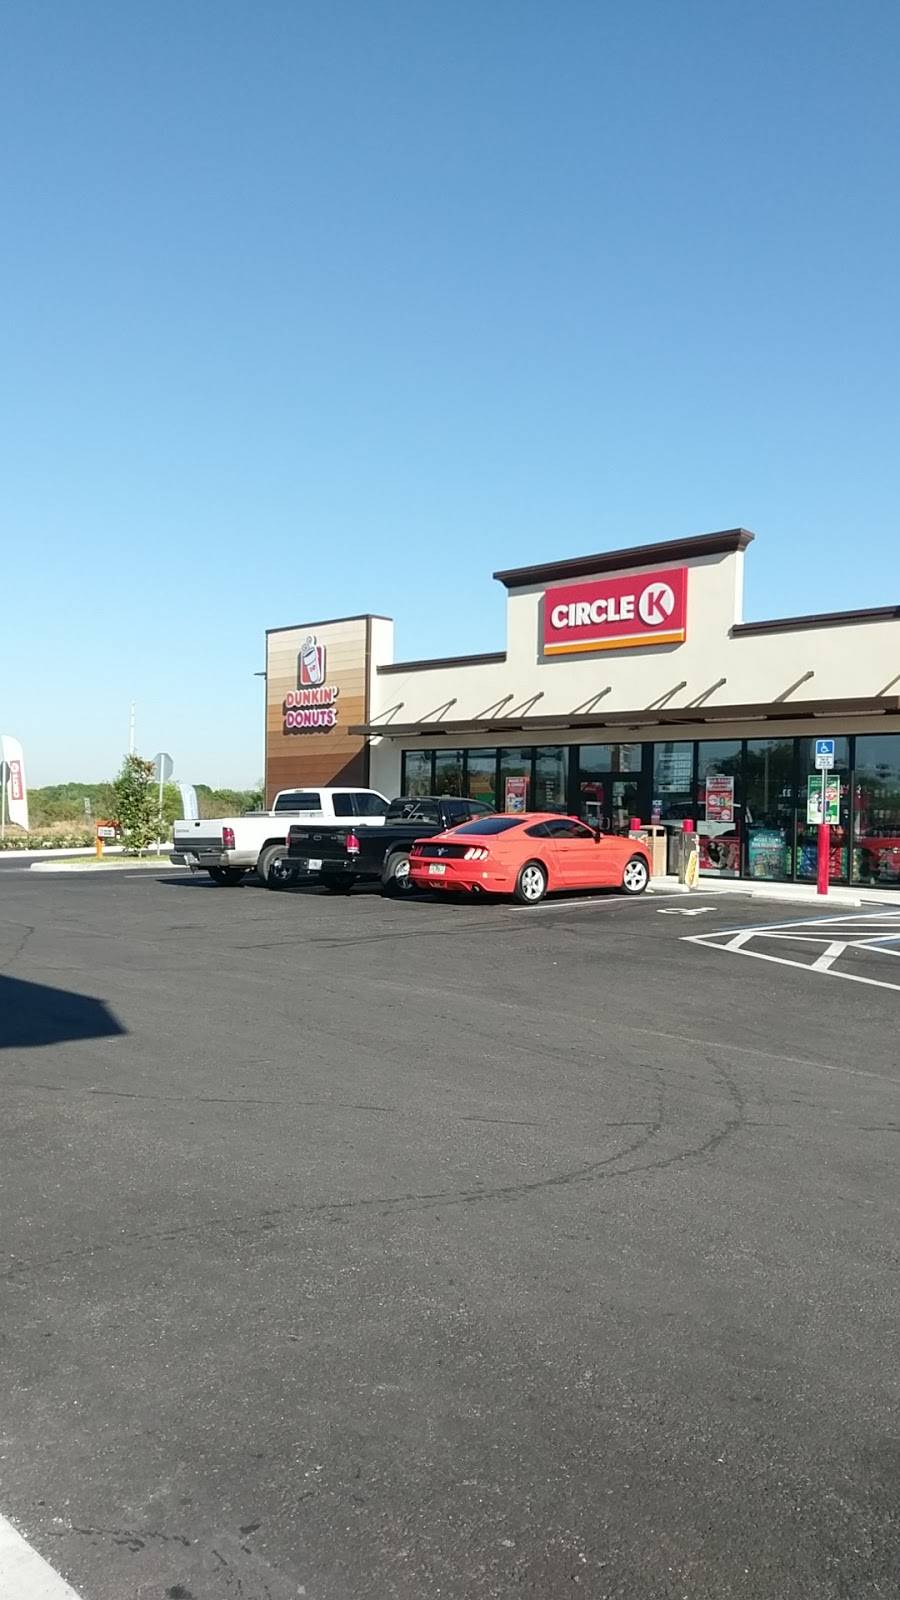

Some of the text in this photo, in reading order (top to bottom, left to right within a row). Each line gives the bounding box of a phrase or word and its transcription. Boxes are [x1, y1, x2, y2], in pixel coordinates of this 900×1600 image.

[551, 582, 675, 629] CIRCLE K
[286, 687, 337, 707] DUNKIN'
[286, 709, 336, 728] DONUTS
